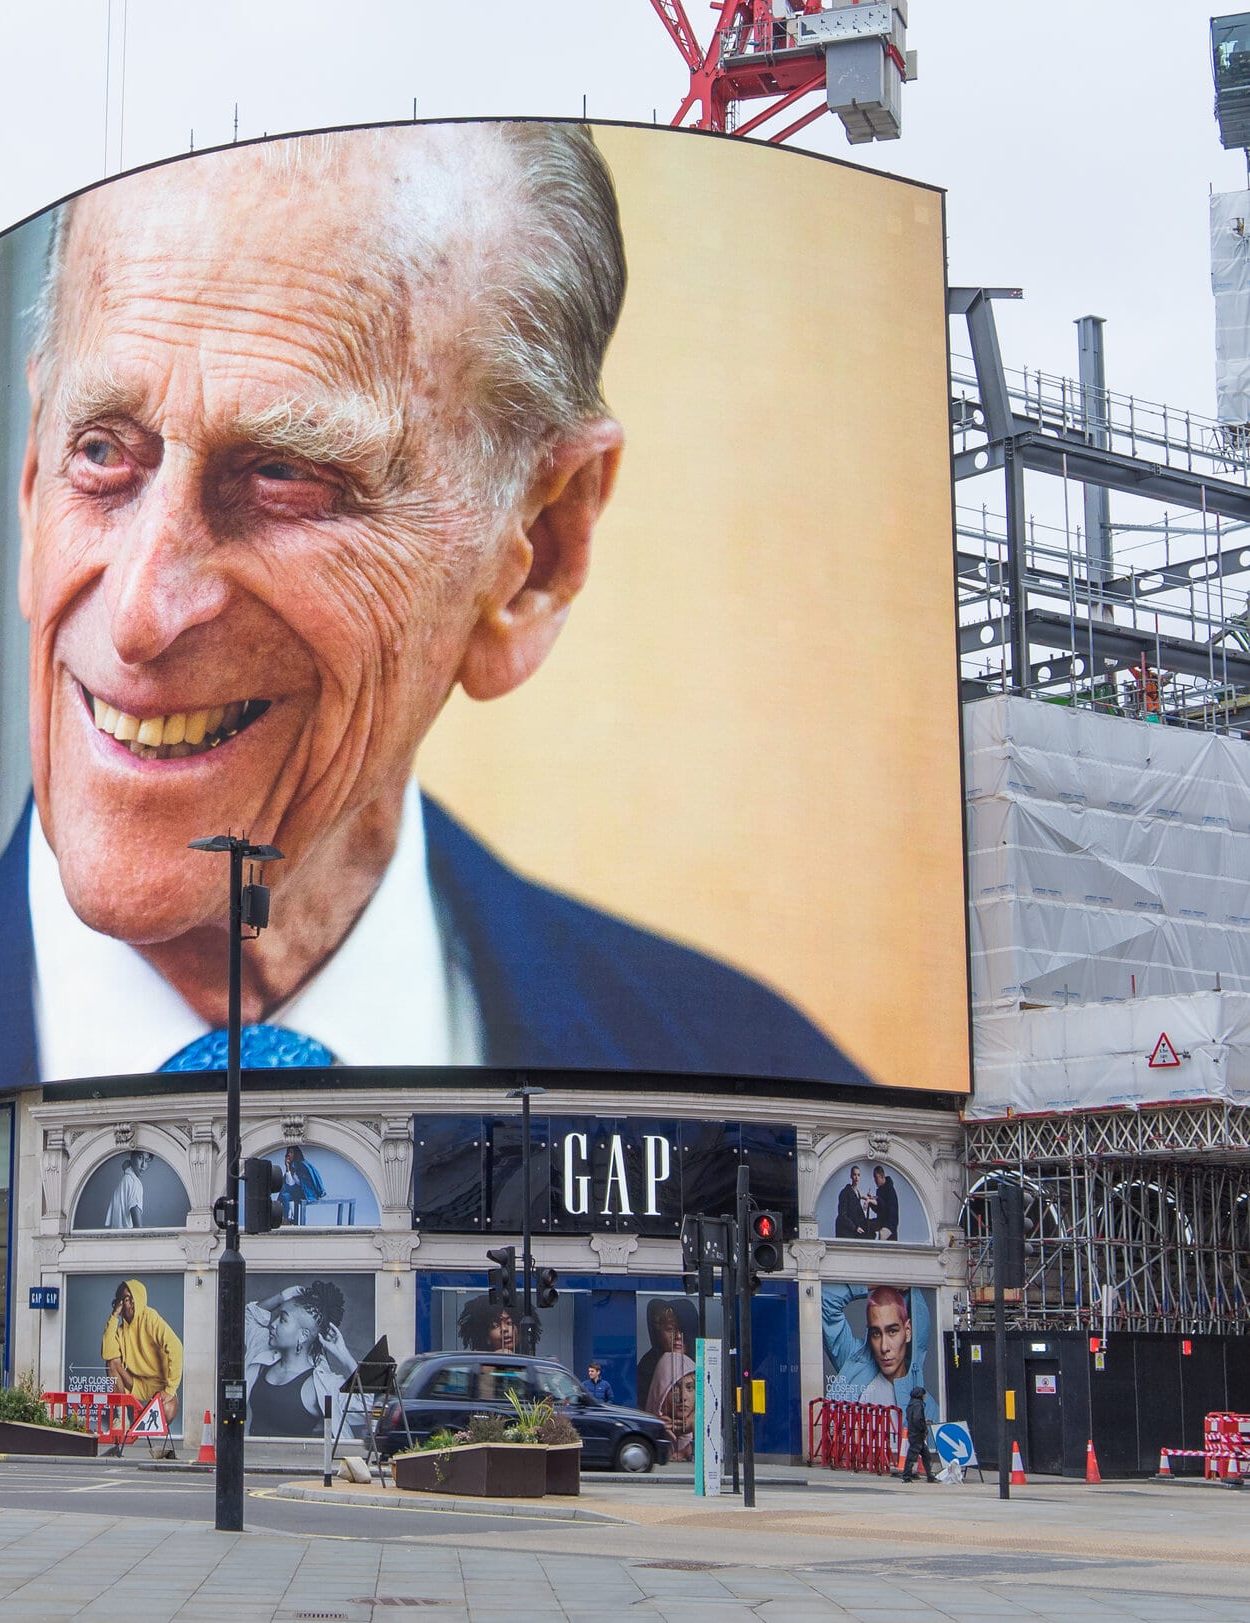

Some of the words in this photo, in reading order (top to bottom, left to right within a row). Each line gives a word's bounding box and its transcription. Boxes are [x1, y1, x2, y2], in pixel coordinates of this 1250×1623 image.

[564, 1132, 670, 1216] GAP
[31, 1293, 42, 1304] GAP
[46, 1293, 57, 1304] GAP
[69, 1376, 87, 1384] YOUR
[88, 1376, 118, 1385] CLOSEST
[826, 1374, 847, 1384] YOUR
[69, 1384, 83, 1392] GAP
[107, 1385, 114, 1393] IS
[826, 1384, 858, 1393] CLOSEST
